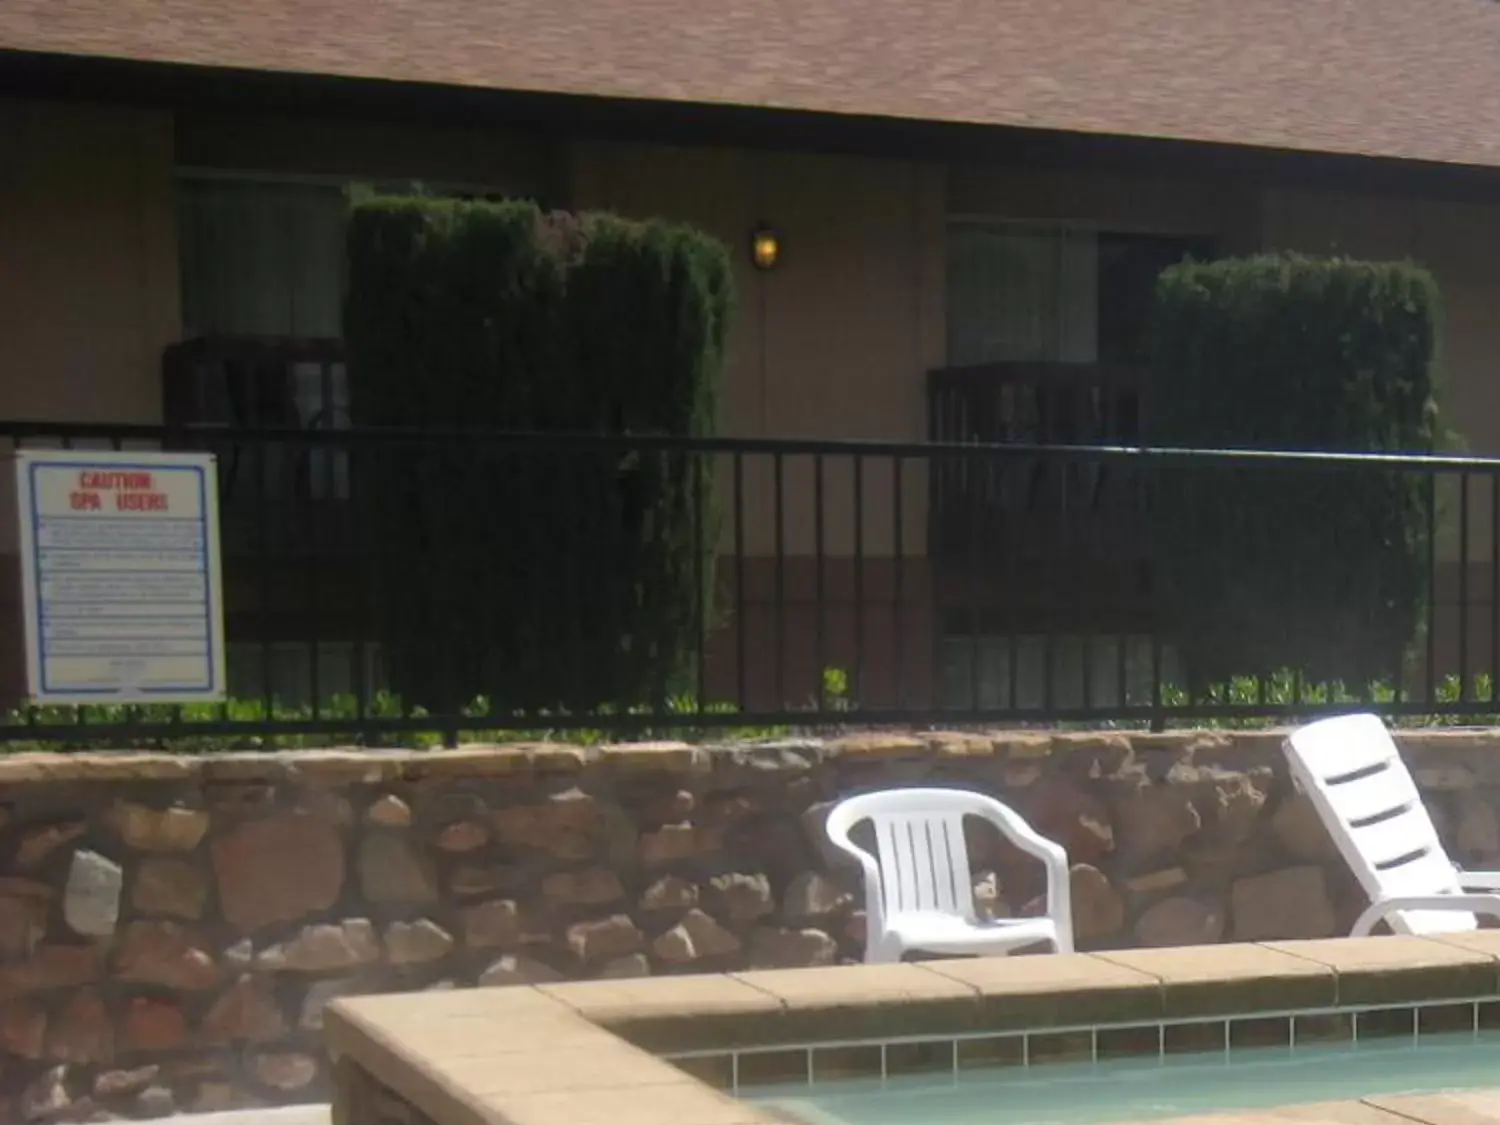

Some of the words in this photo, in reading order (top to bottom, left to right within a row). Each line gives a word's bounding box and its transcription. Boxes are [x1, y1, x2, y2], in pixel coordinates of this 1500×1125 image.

[80, 472, 151, 489] CAUTION
[69, 491, 101, 510] SPA
[116, 492, 169, 512] USERS
